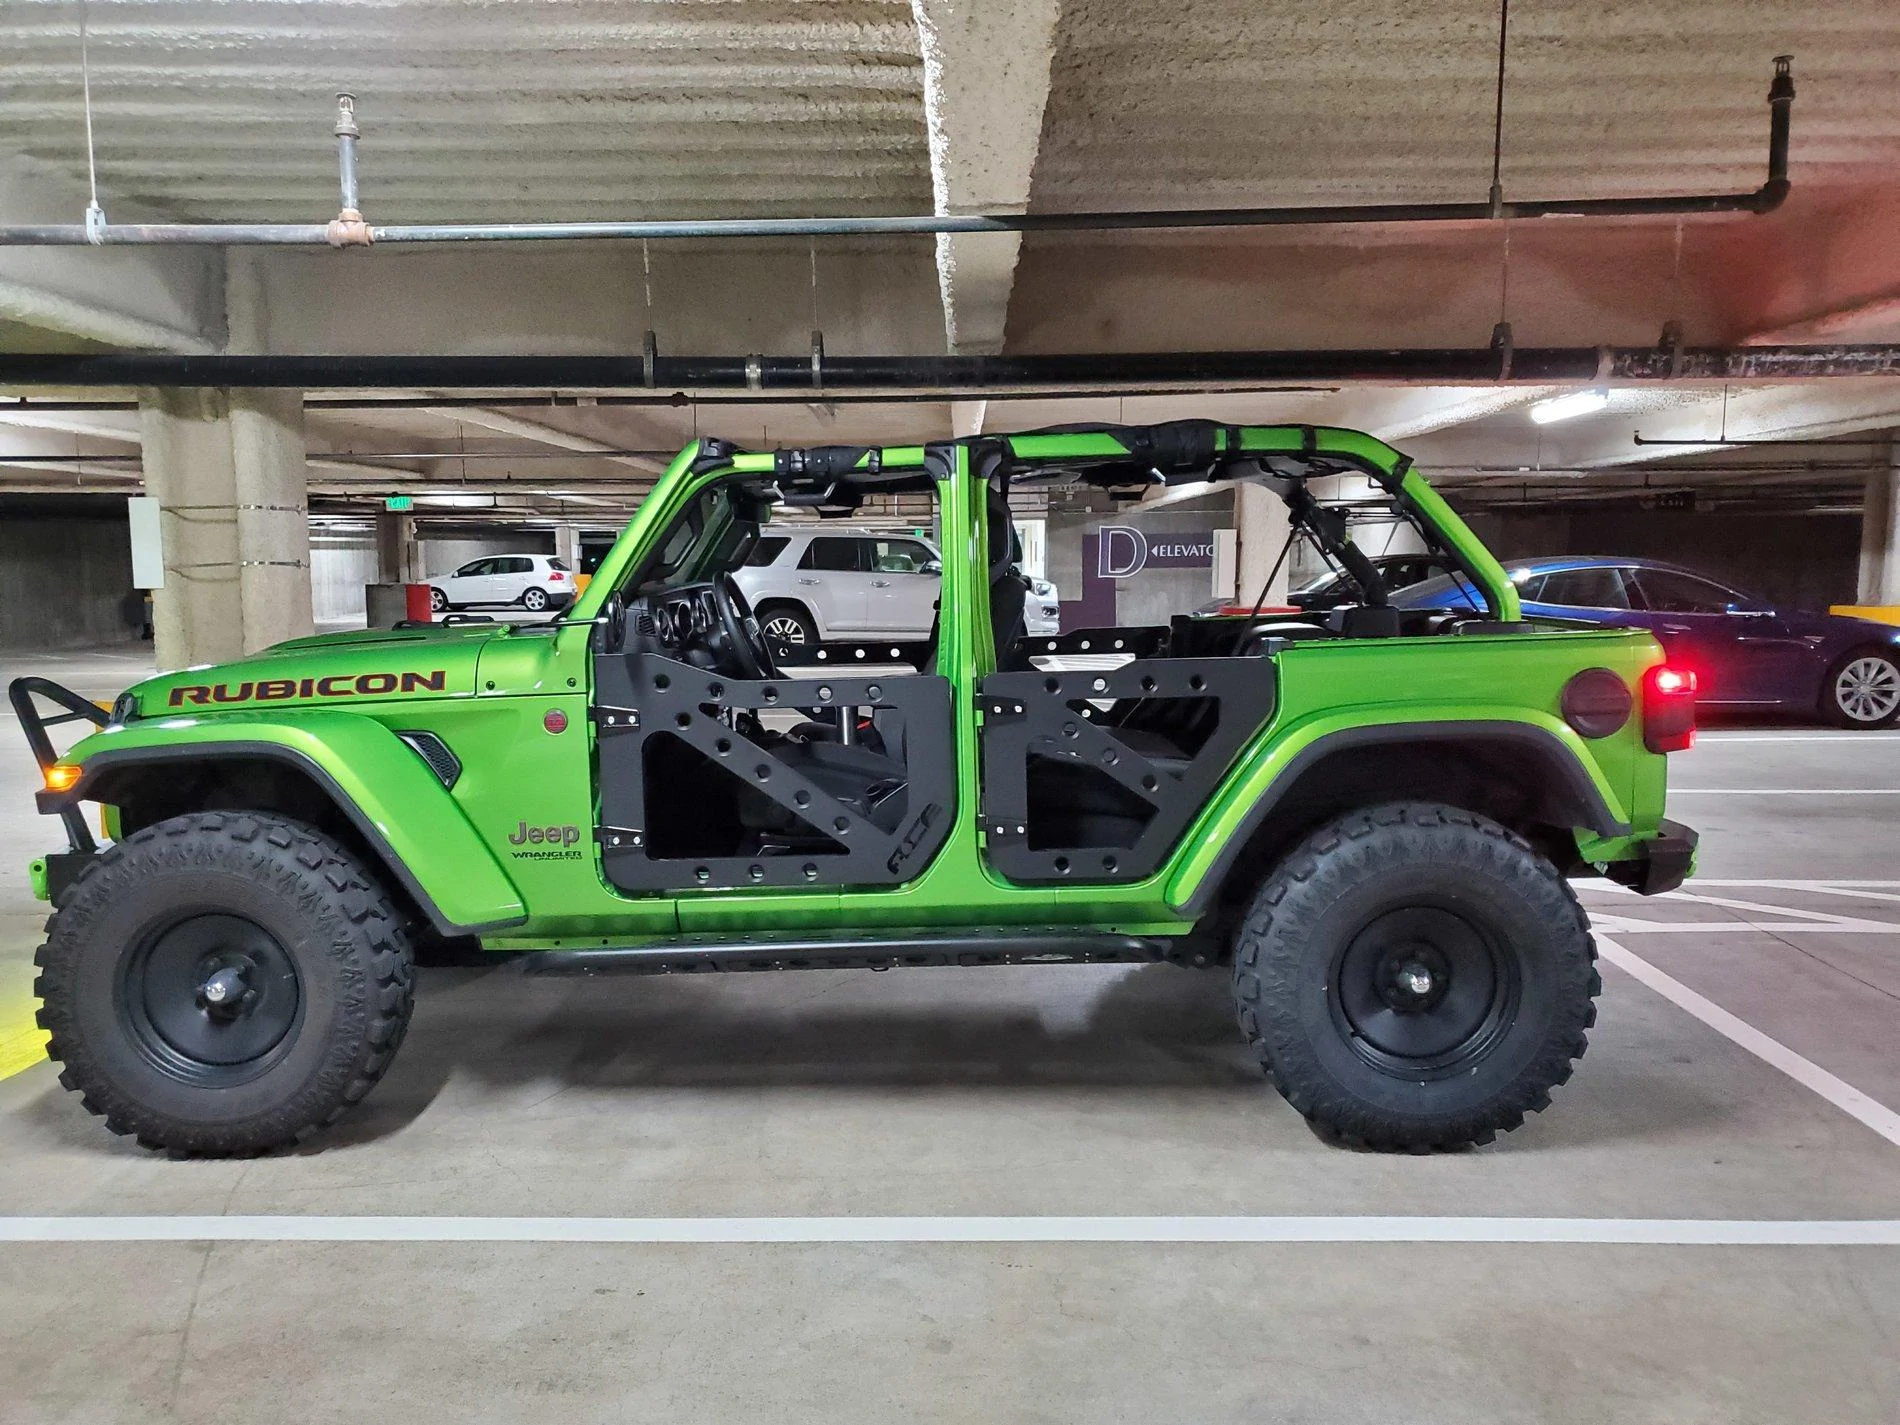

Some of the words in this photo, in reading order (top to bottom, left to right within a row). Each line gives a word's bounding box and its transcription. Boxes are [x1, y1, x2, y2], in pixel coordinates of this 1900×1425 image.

[1098, 525, 1148, 578] D
[168, 670, 446, 707] RUBICON
[508, 820, 581, 848] Jeep
[511, 850, 583, 859] WRANGLER
